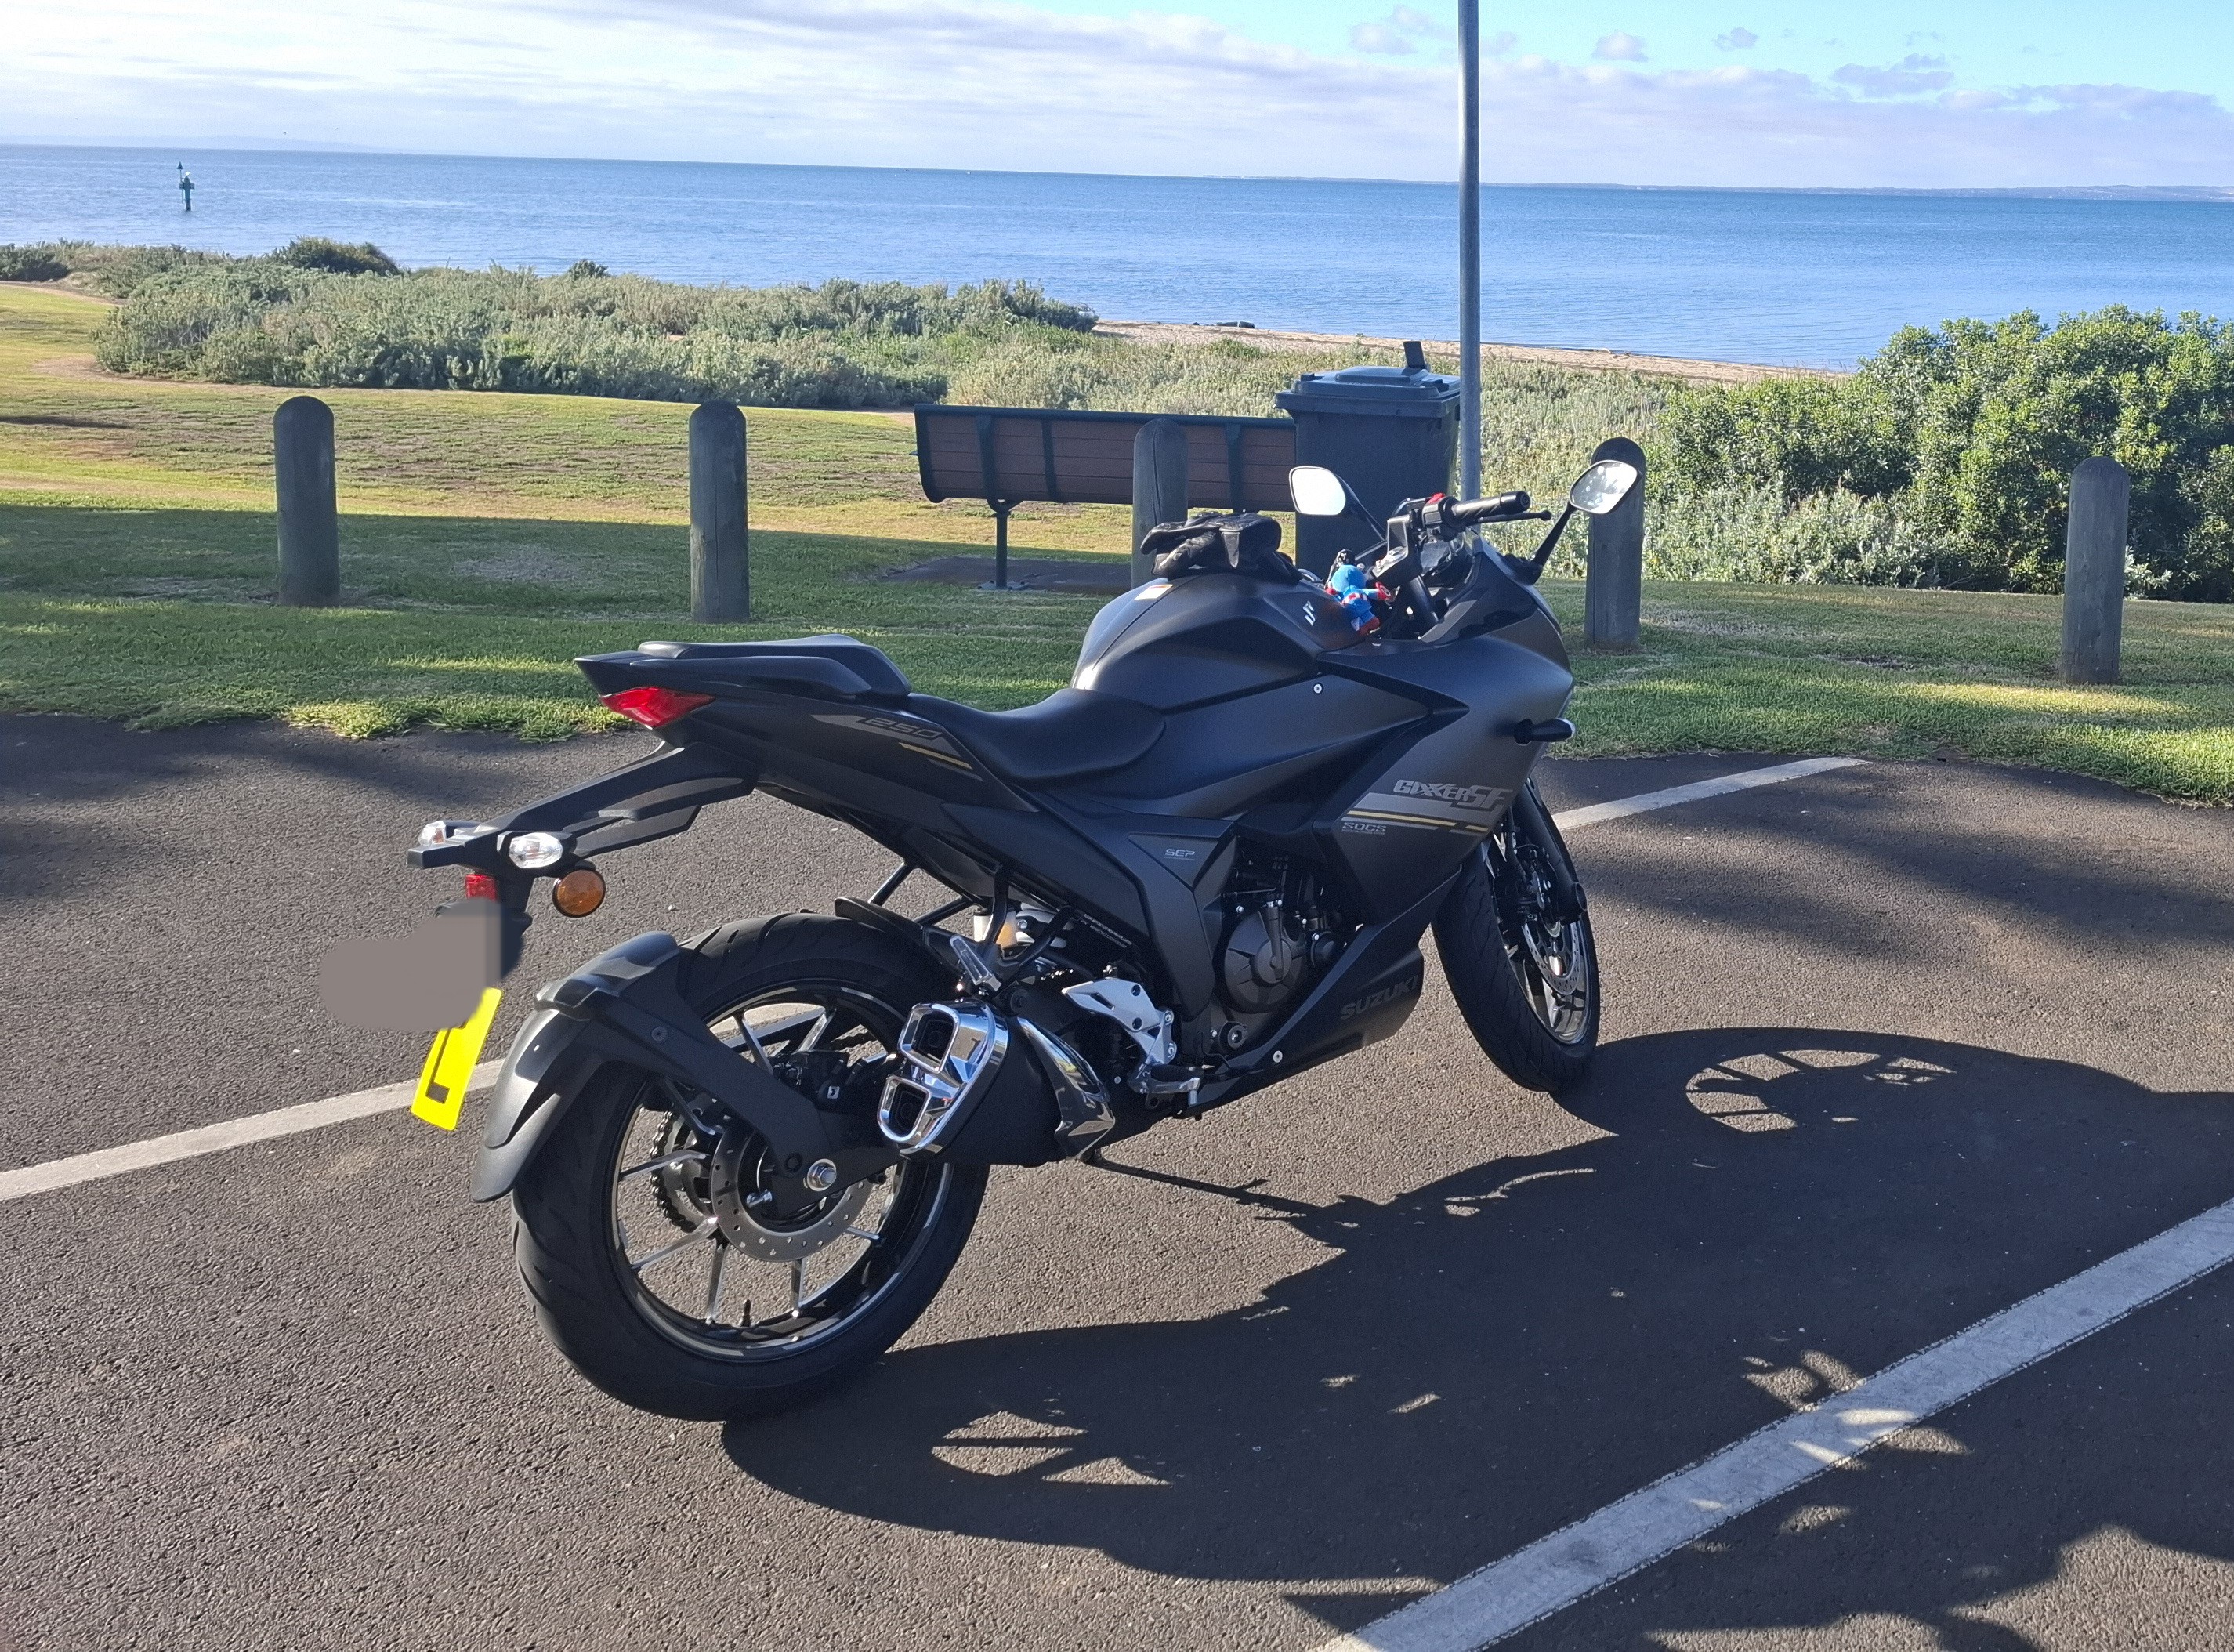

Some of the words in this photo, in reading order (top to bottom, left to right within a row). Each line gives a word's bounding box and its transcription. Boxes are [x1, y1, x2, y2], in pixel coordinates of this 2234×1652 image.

[865, 717, 942, 738] 250
[1342, 822, 1386, 832] SOCS
[1164, 848, 1196, 858] SEP
[1340, 974, 1418, 1020] SUZUKI
